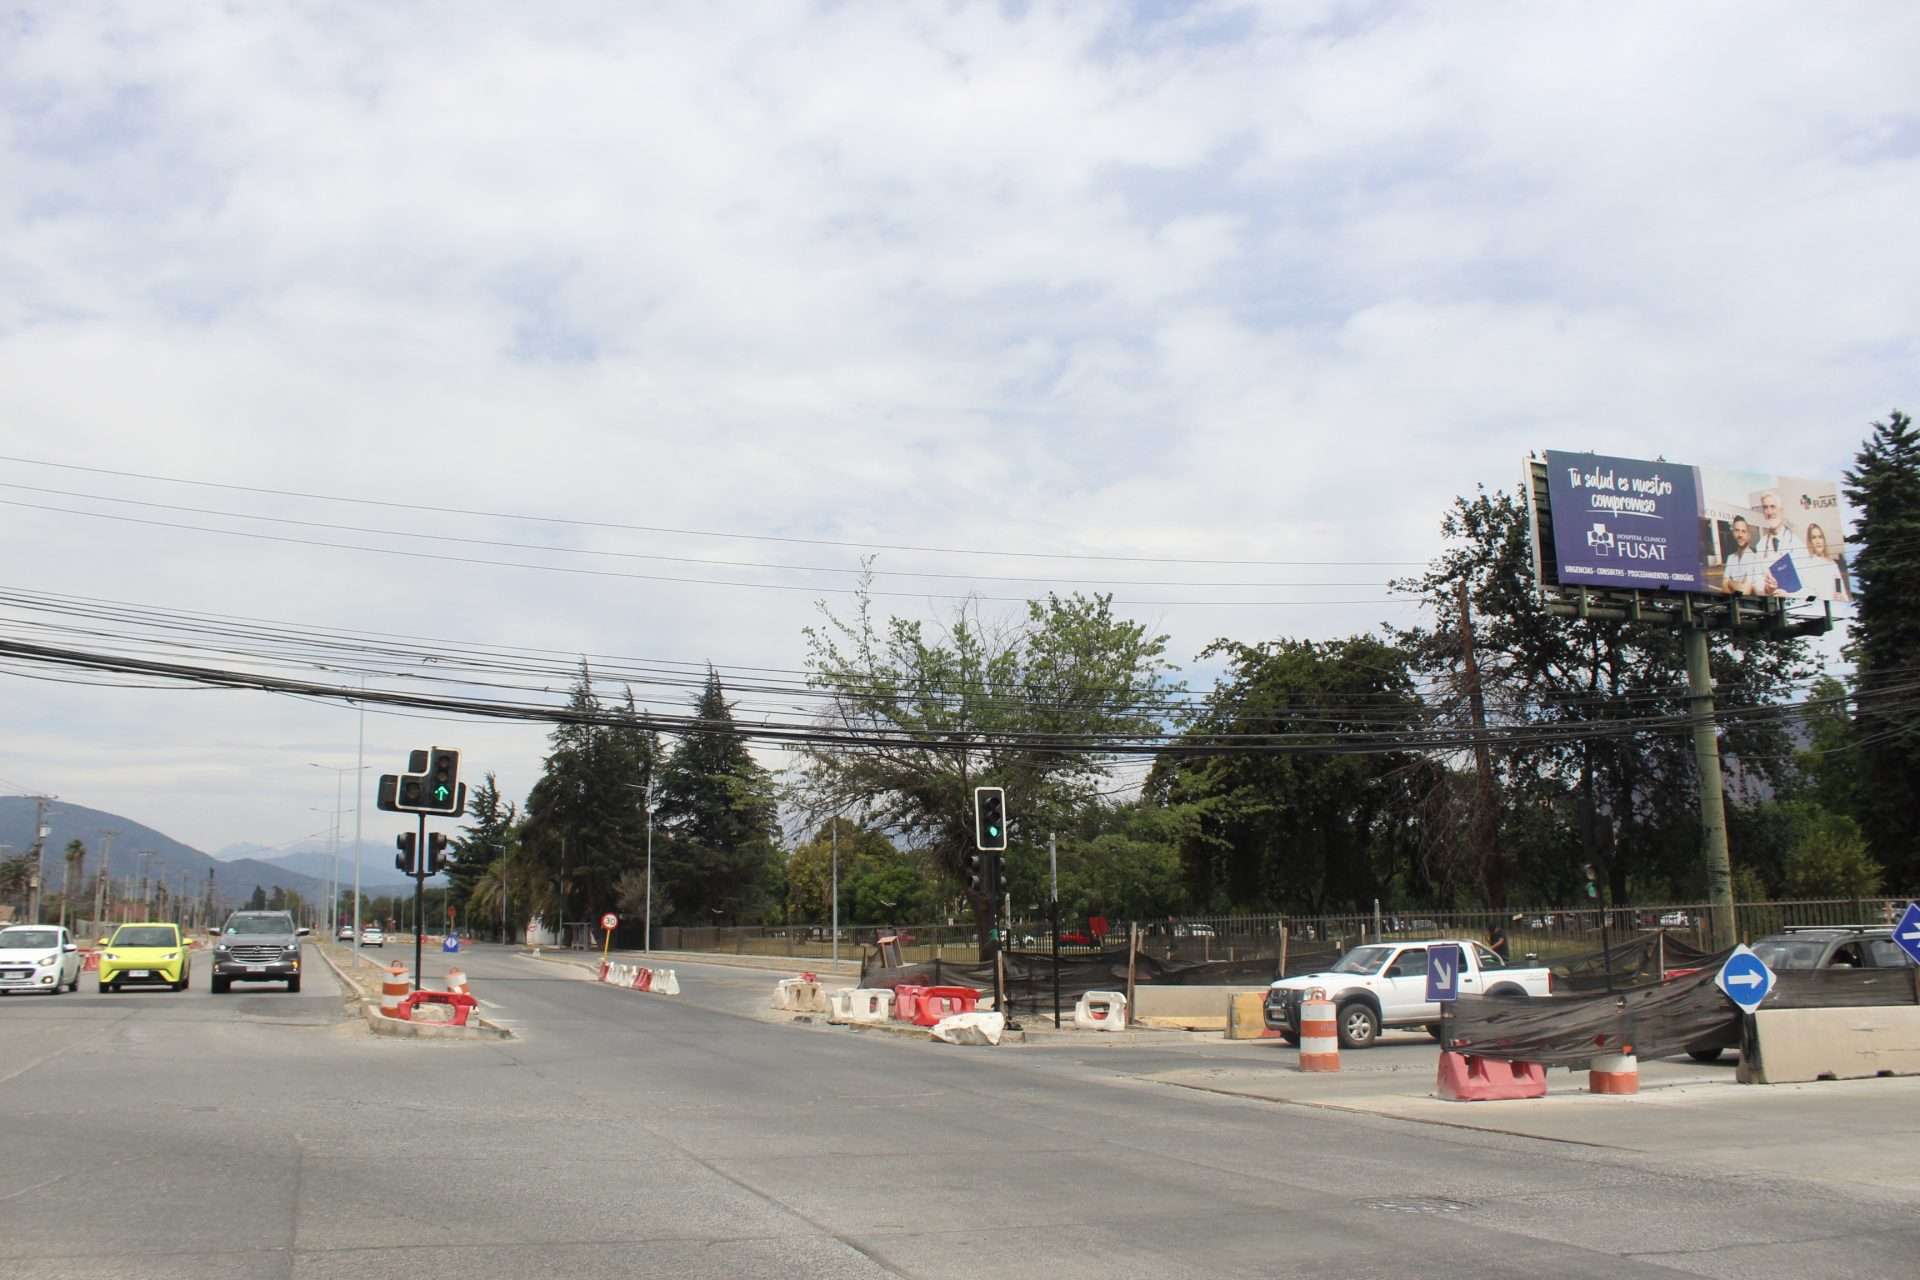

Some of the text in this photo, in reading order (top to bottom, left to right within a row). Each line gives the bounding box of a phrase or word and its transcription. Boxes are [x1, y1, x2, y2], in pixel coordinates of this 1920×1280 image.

[1568, 466, 1672, 497] Tu salud es nuestro
[1591, 494, 1656, 518] compromiso
[1617, 541, 1667, 560] FUSAT
